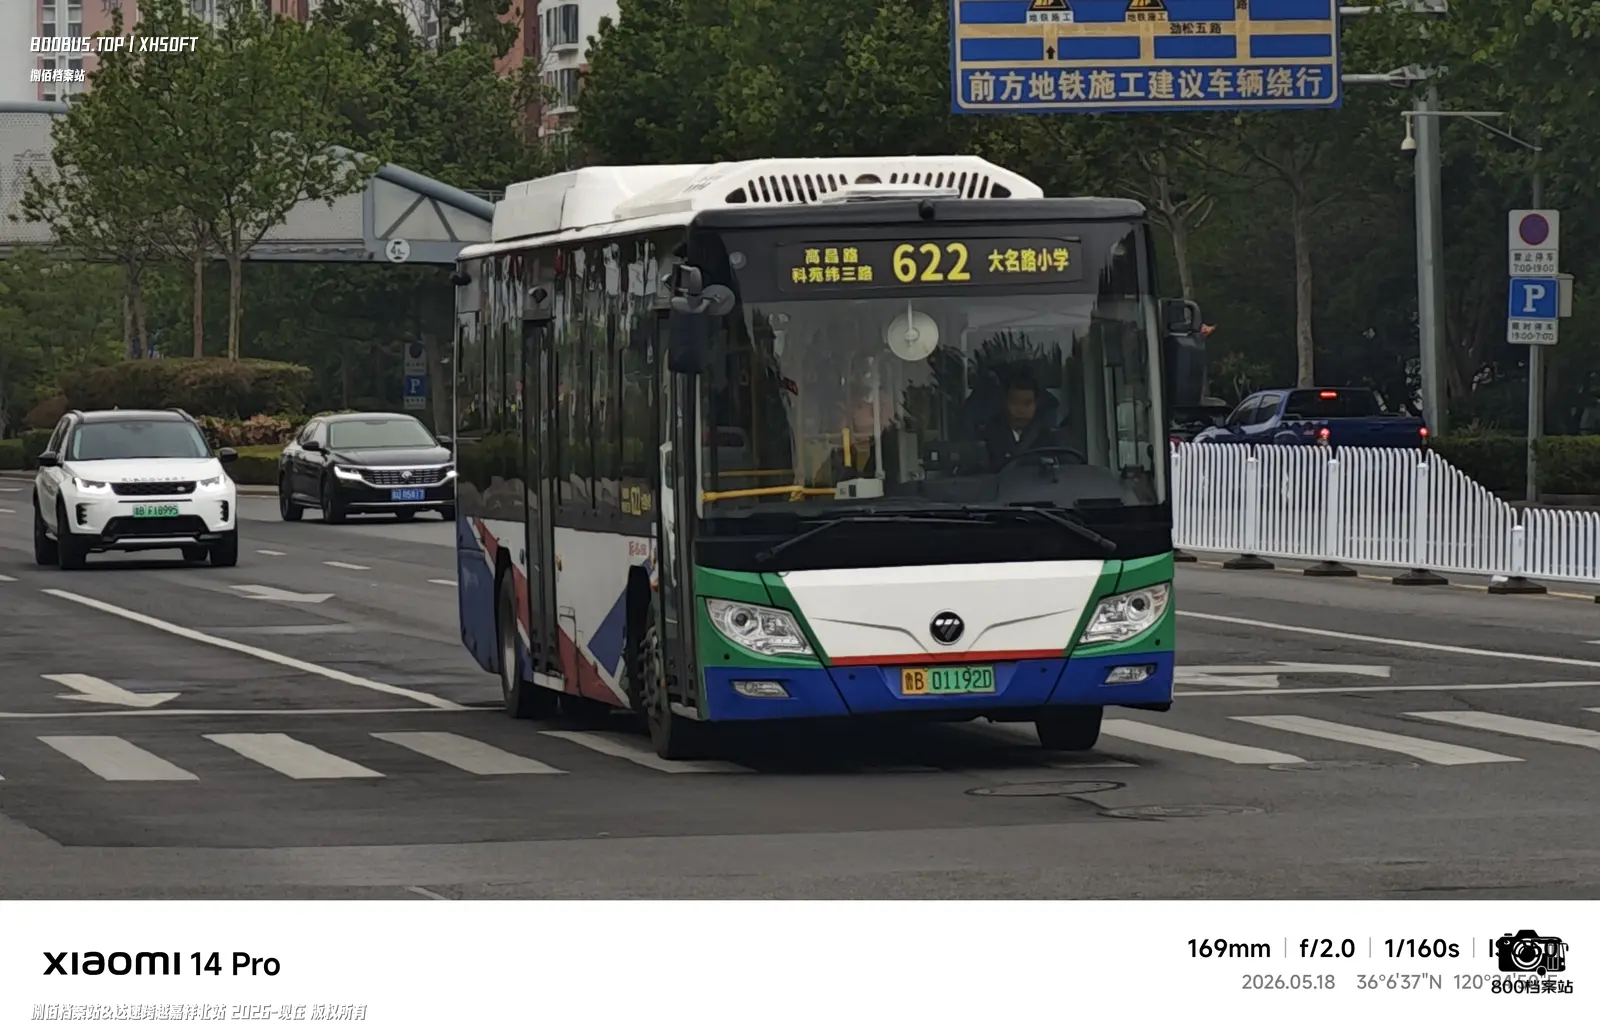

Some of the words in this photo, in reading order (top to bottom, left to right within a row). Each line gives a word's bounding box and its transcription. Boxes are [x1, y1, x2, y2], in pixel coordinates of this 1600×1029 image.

[1029, 12, 1071, 22] 地铁施工
[1127, 12, 1166, 22] 地铁施工
[1170, 22, 1222, 34] 劲松五路
[968, 67, 1324, 102] 前方地铁施工建议车辆绕行
[893, 242, 971, 282] 622
[988, 248, 1069, 273] 大名路小学
[791, 265, 873, 283] 科苑纬三路
[1522, 284, 1546, 312] P
